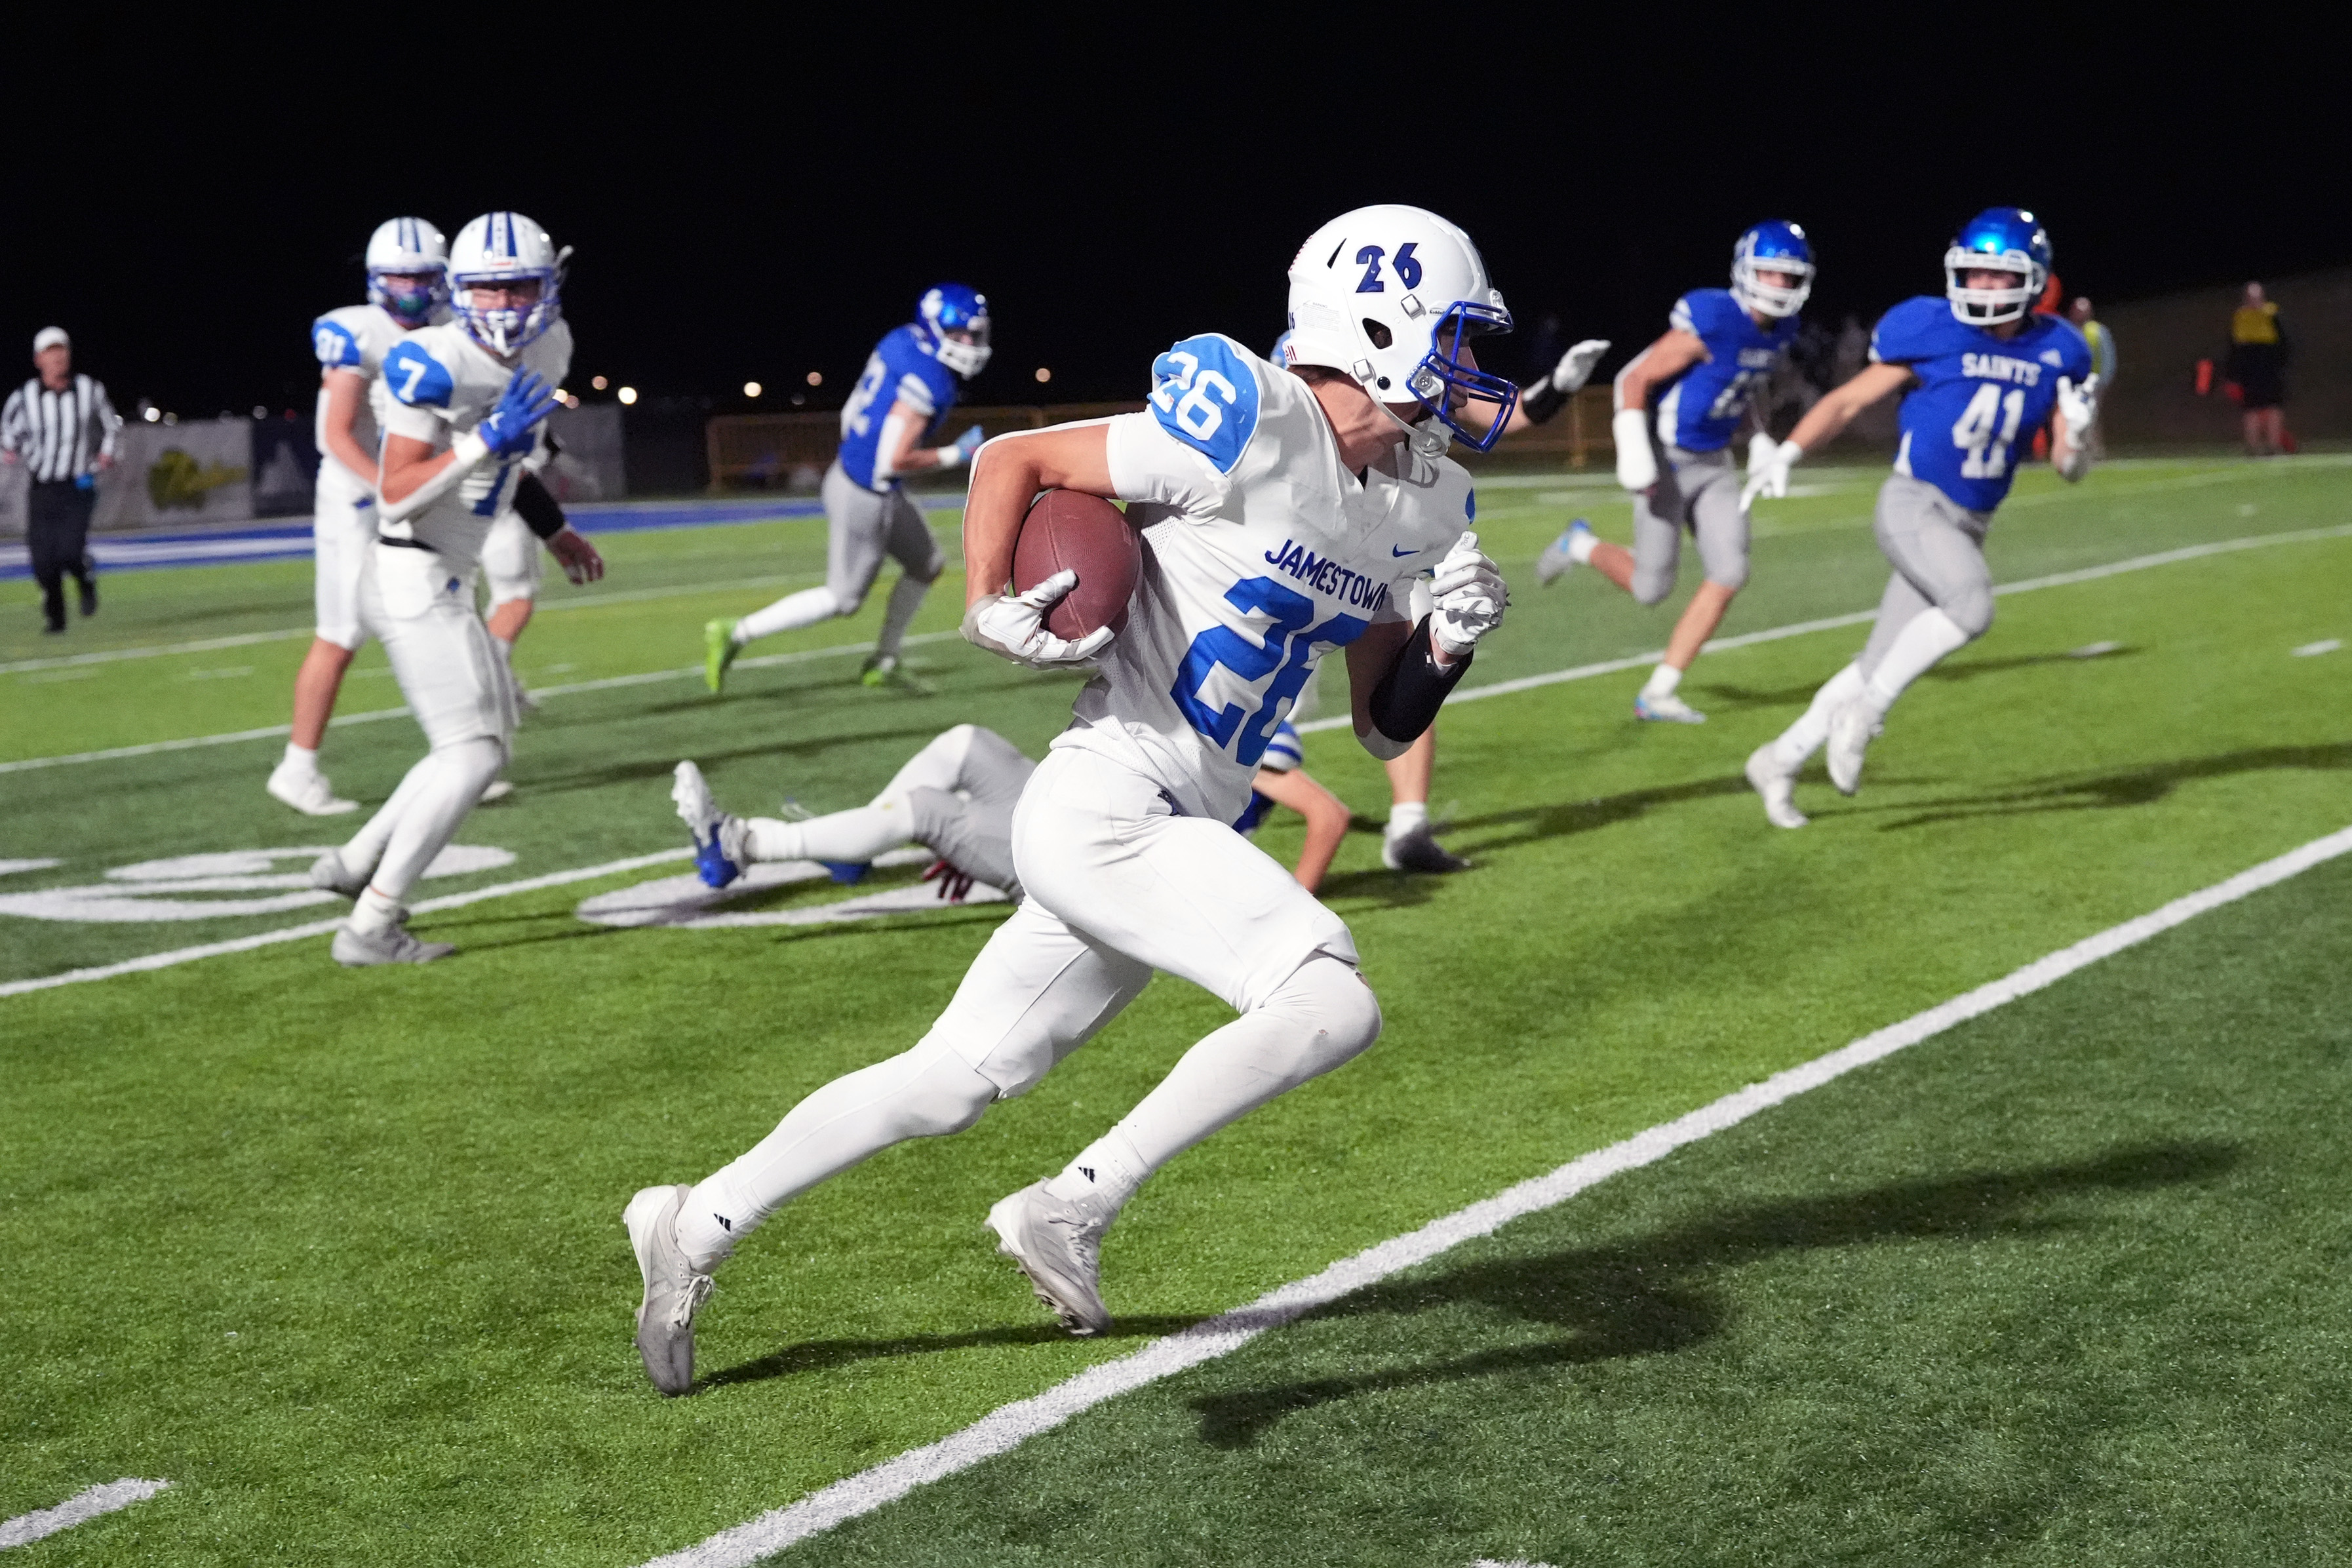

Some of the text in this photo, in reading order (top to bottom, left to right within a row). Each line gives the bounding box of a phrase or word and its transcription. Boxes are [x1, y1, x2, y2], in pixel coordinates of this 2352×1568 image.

[1356, 243, 1422, 293] 26
[399, 357, 426, 402] 7
[1150, 351, 1237, 441] 26
[1961, 352, 2042, 387] SAINTS
[1951, 382, 2026, 479] 41
[1264, 539, 1389, 612] JAMESTOWN
[1169, 576, 1371, 767] 26
